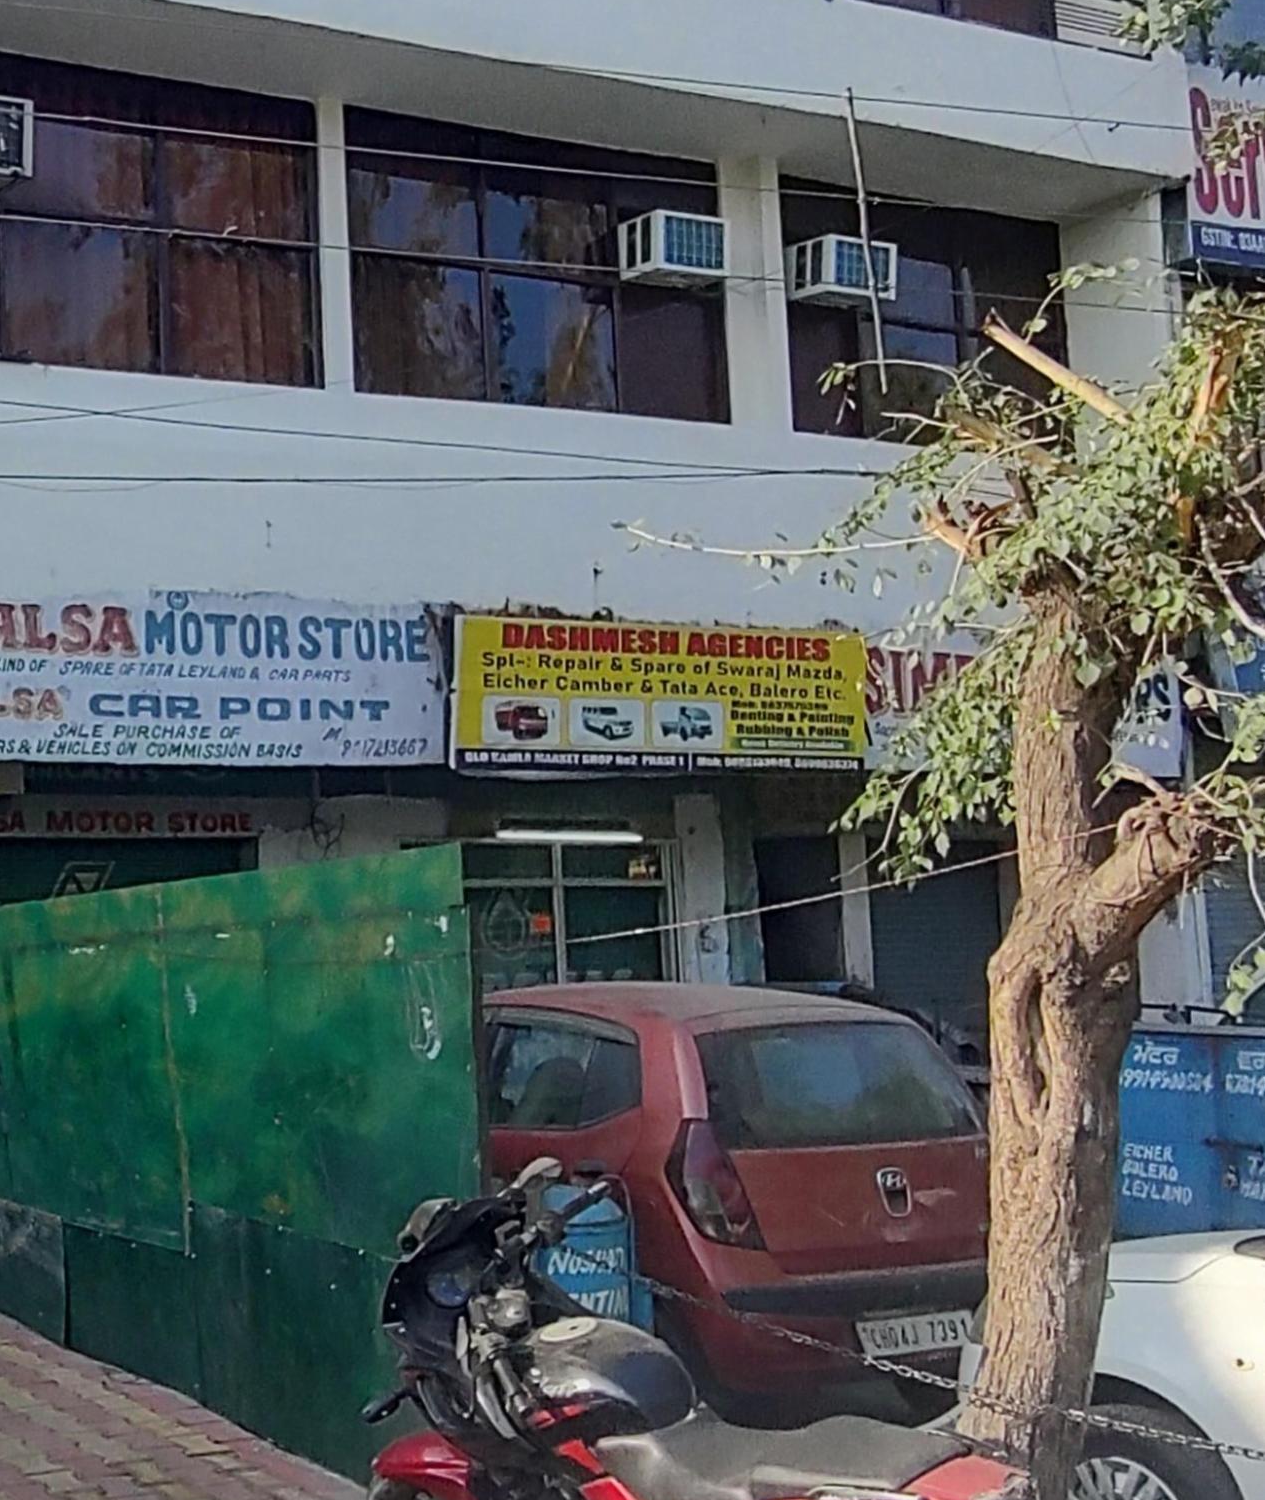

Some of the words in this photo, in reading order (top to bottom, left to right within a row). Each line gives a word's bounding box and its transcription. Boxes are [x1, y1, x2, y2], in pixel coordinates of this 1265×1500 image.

[144, 608, 290, 660] MOTOR
[298, 615, 431, 663] STORE
[501, 622, 680, 656] DASHMESH
[686, 632, 831, 663] AGENCIES
[28, 658, 49, 673] OF
[58, 660, 114, 676] SPARE
[137, 662, 173, 678] TATA
[177, 664, 246, 680] LEYLAND
[268, 667, 300, 682] CAR
[302, 668, 352, 683] PARTS
[538, 653, 603, 673] Repair
[610, 657, 623, 672] &
[630, 657, 686, 676] Spare
[692, 661, 711, 675] of
[716, 661, 781, 682] Swaraj
[786, 663, 847, 684] Mazda,
[482, 672, 550, 690] Eicher
[555, 675, 634, 693] Camber
[640, 679, 654, 694] &
[659, 679, 698, 695] Tata
[704, 682, 744, 699] Ace,
[750, 683, 809, 700] Balero
[814, 684, 847, 701] Etc.
[88, 690, 202, 720] CAR
[219, 695, 391, 722] POINT
[730, 709, 785, 722] Denting
[799, 712, 855, 726] Painting
[53, 722, 104, 739] SALE
[113, 723, 212, 740] PURCHASE
[219, 725, 242, 740] OF
[736, 723, 793, 738] Rubbing
[808, 725, 850, 738] Polish
[17, 739, 32, 755] &
[36, 739, 111, 756] VEHICLES
[116, 740, 136, 757] ON
[146, 741, 251, 759] COMMISSION
[256, 742, 303, 760] BASIS
[46, 809, 156, 834] MOTOR
[167, 810, 253, 834] STORE
[1123, 1142, 1174, 1163] EICHER
[1121, 1177, 1194, 1206] LEYLAND
